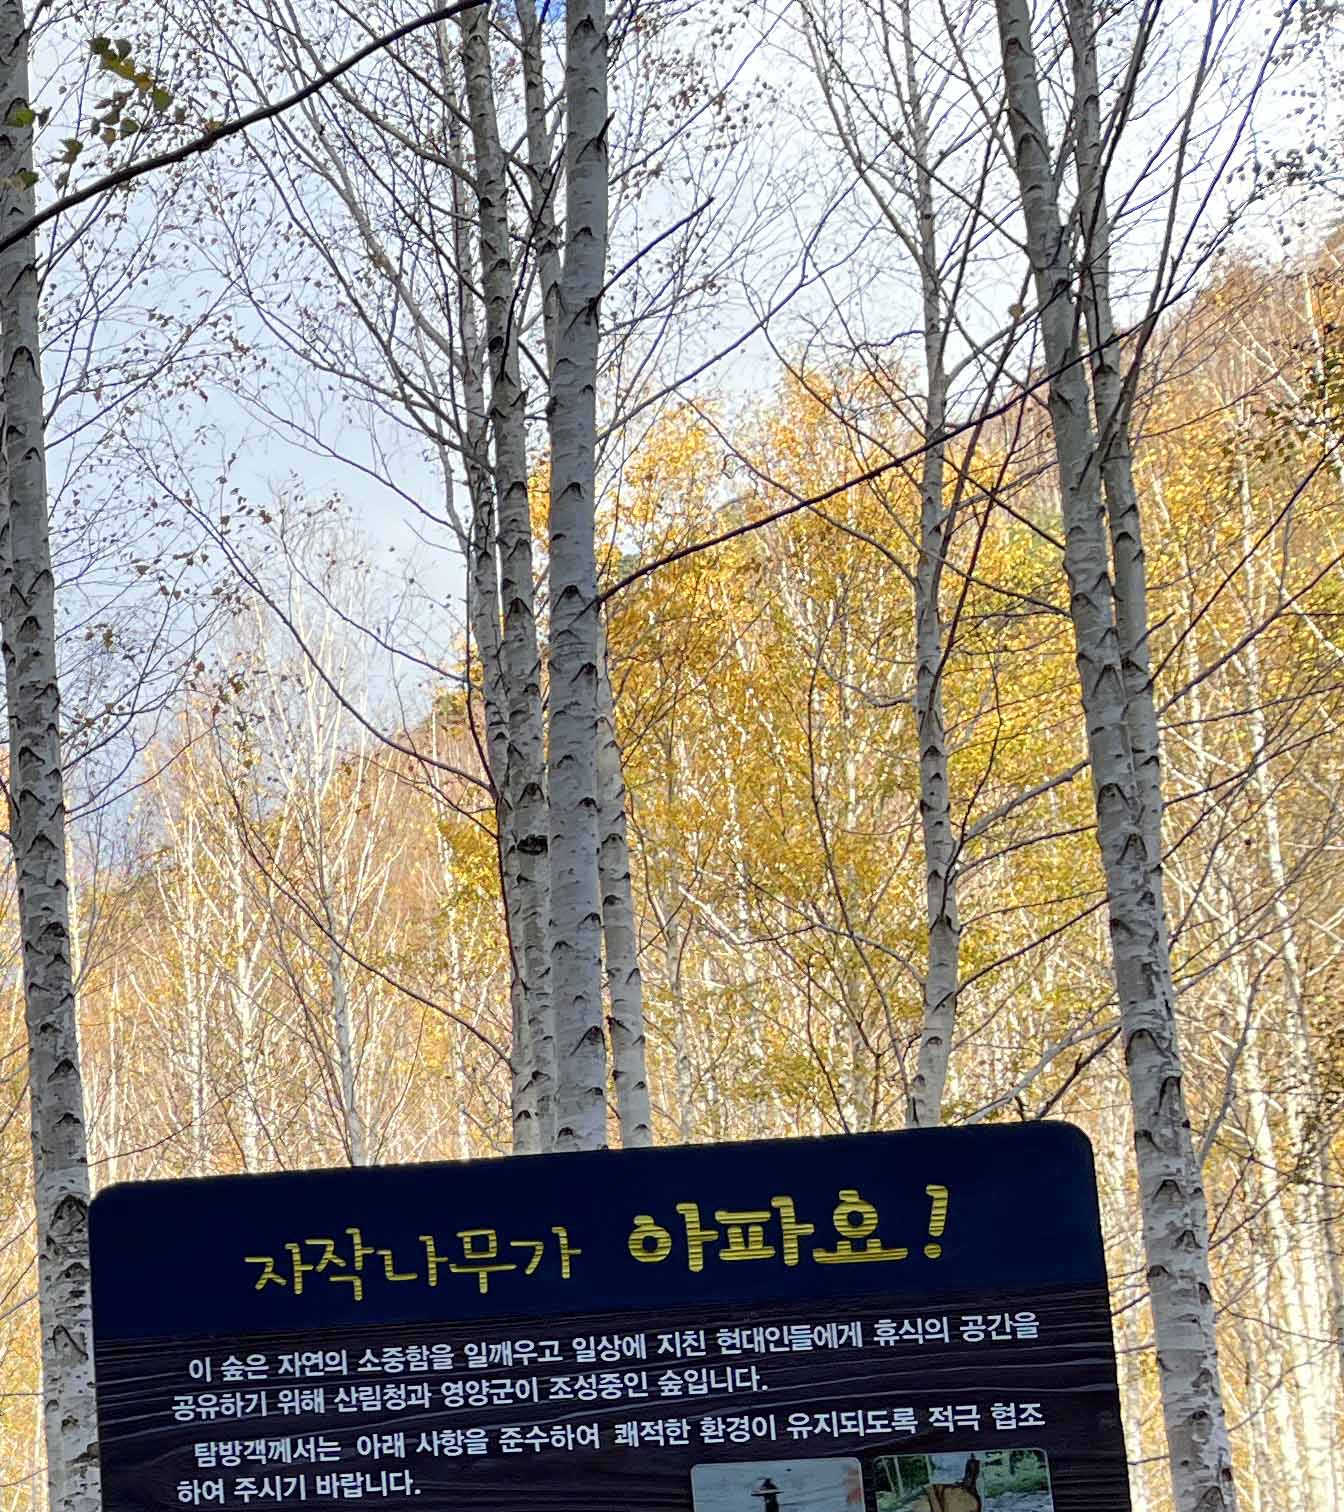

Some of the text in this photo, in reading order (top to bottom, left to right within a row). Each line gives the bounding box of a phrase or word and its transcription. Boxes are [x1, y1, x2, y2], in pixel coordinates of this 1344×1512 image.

[244, 1184, 950, 1301] 자작나무가 아파요!
[189, 1311, 1039, 1382] 이 숲은 자연의 소중함을 일깨우고 일상에 지친 현대인들에게 휴식의 공간을
[171, 1365, 769, 1421] 공유하기 위해 산림청과 영양군이 조성중인 숲입니다.
[193, 1401, 1046, 1468] 탐방객께서는 아래 사항을 준수하여 쾌적한 환경이 유지되도록 적극 협조
[176, 1469, 422, 1505] 하여 주시기 바랍니다.
